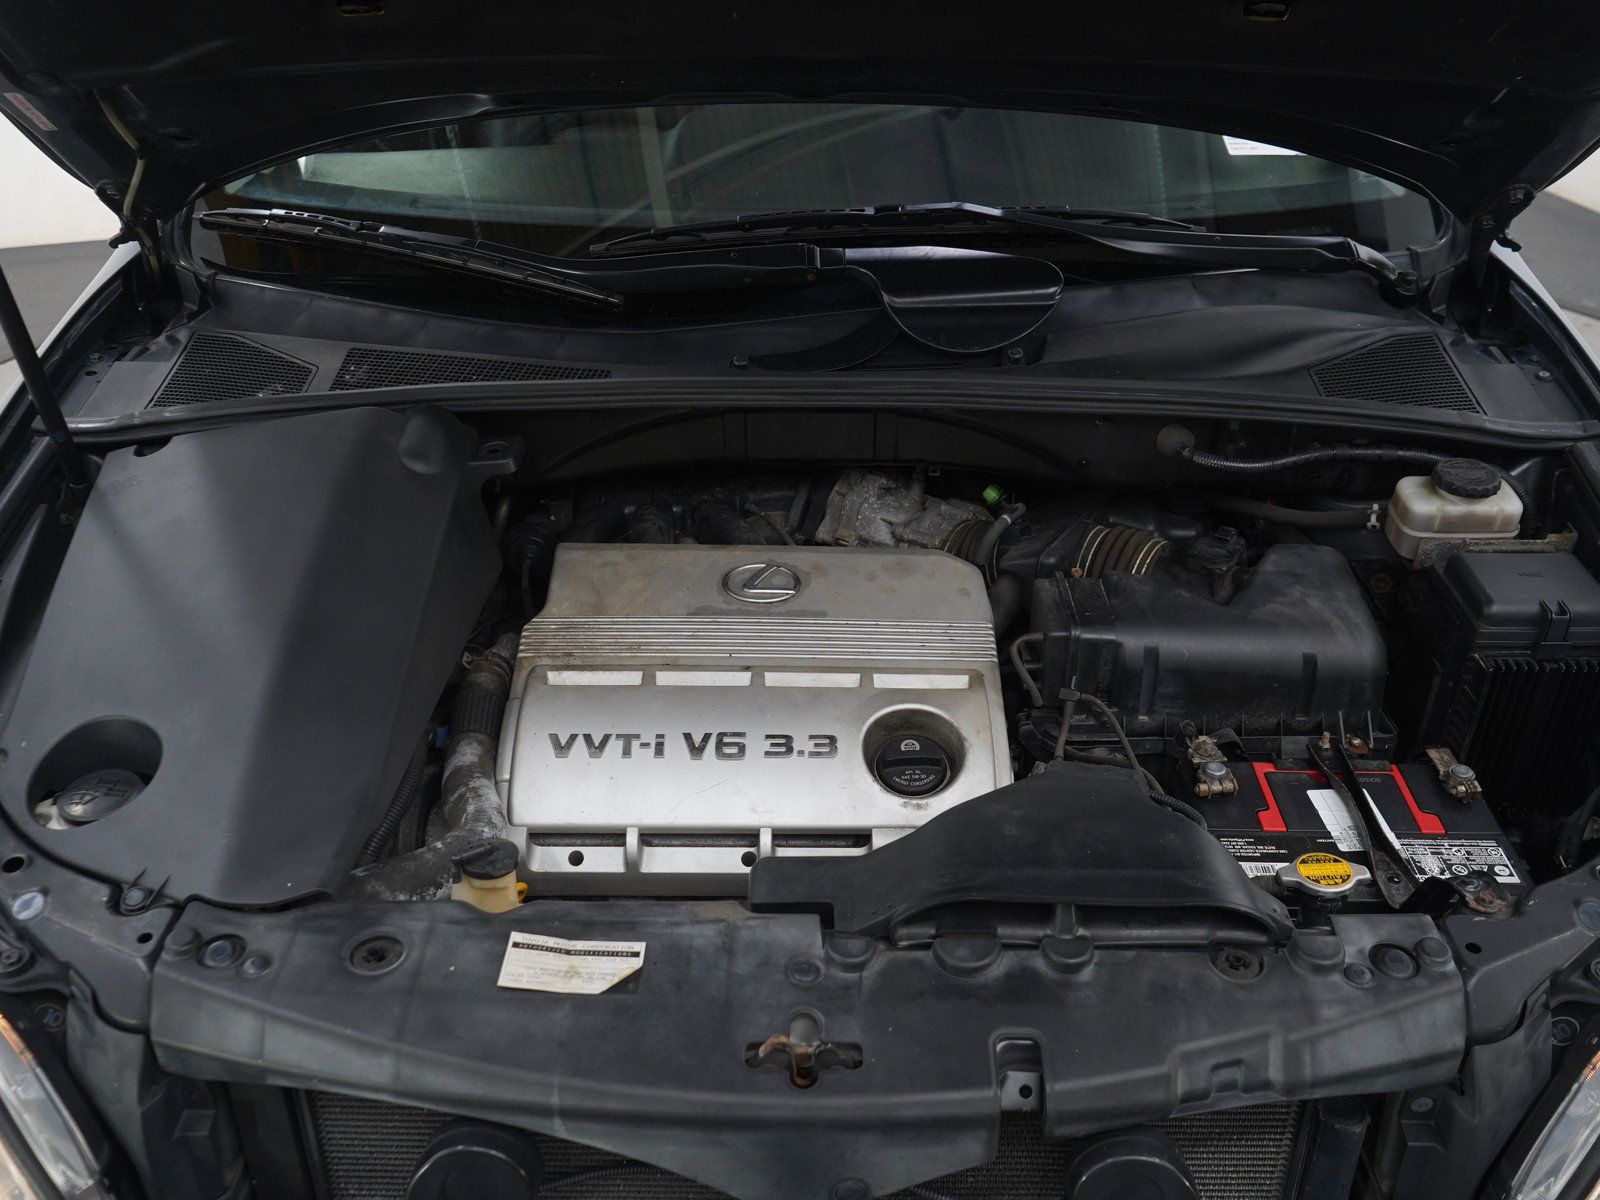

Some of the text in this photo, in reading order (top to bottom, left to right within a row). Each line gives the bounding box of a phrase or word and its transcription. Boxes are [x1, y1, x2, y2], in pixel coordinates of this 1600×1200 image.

[548, 731, 839, 761] VVT-i V6 3.3
[892, 774, 936, 786] ENERGY CONSERVING
[1309, 873, 1347, 881] CAUTION
[518, 943, 566, 953] AUTHORIZED
